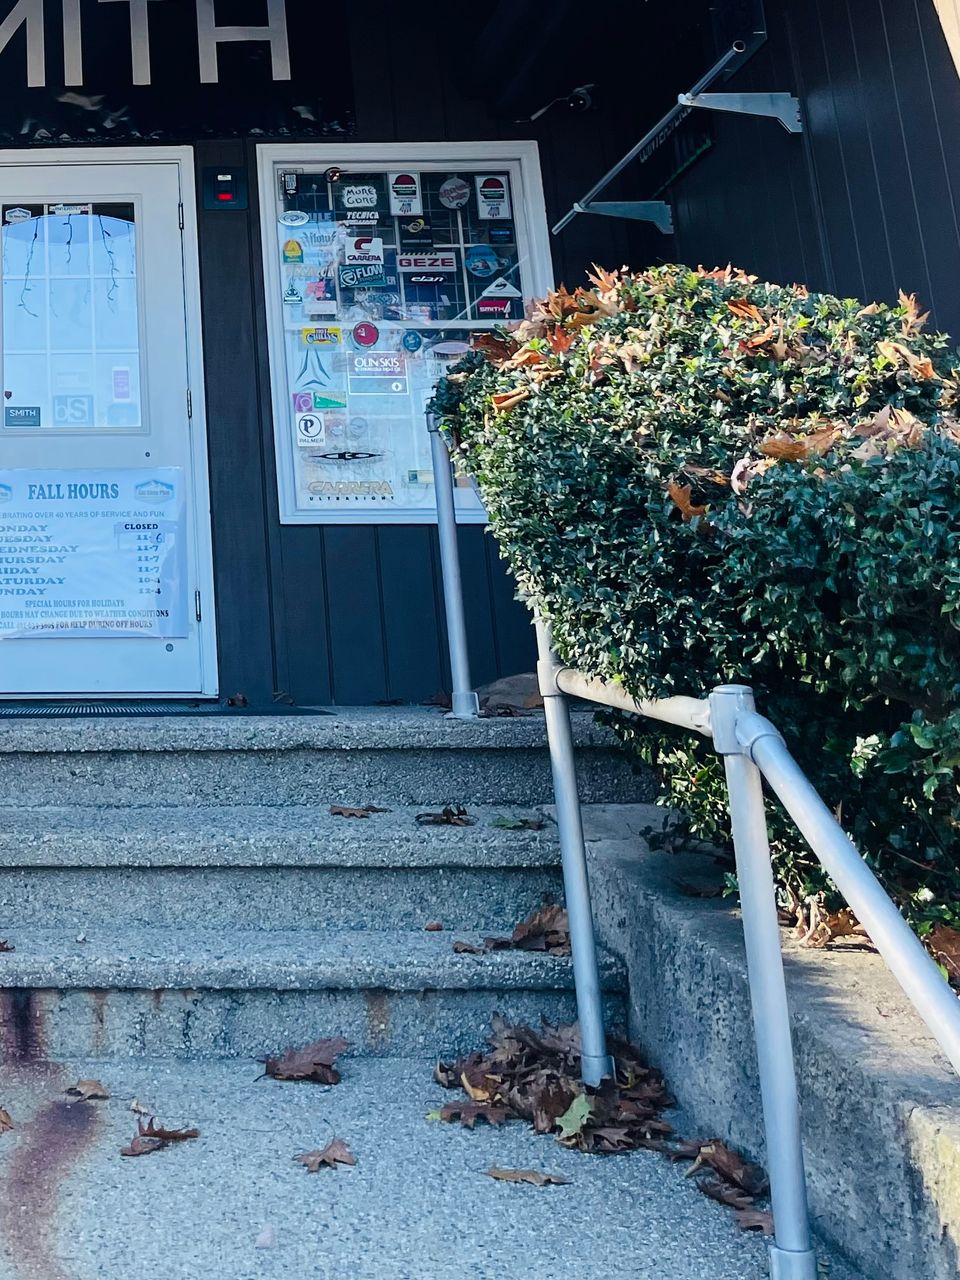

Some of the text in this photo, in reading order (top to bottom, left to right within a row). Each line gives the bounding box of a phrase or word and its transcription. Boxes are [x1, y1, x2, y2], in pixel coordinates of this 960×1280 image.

[346, 211, 379, 219] TECNICA
[399, 258, 454, 267] GEZE
[356, 264, 382, 278] FLOW
[380, 357, 400, 367] SKIS
[9, 409, 36, 417] SMITH
[28, 483, 119, 500] FALL HOURS
[307, 481, 394, 496] CARRERA
[25, 600, 53, 608] SPECIAL
[53, 600, 76, 608] HOURS
[0, 611, 24, 619] HOURS
[24, 610, 39, 618] MAY
[40, 610, 67, 618] CHANGE
[69, 610, 83, 618] DUE
[84, 610, 94, 618] TO
[127, 609, 169, 617] CONDITIONS
[55, 621, 70, 629] FOR
[115, 620, 129, 628] OFF
[129, 620, 153, 628] HOURS
